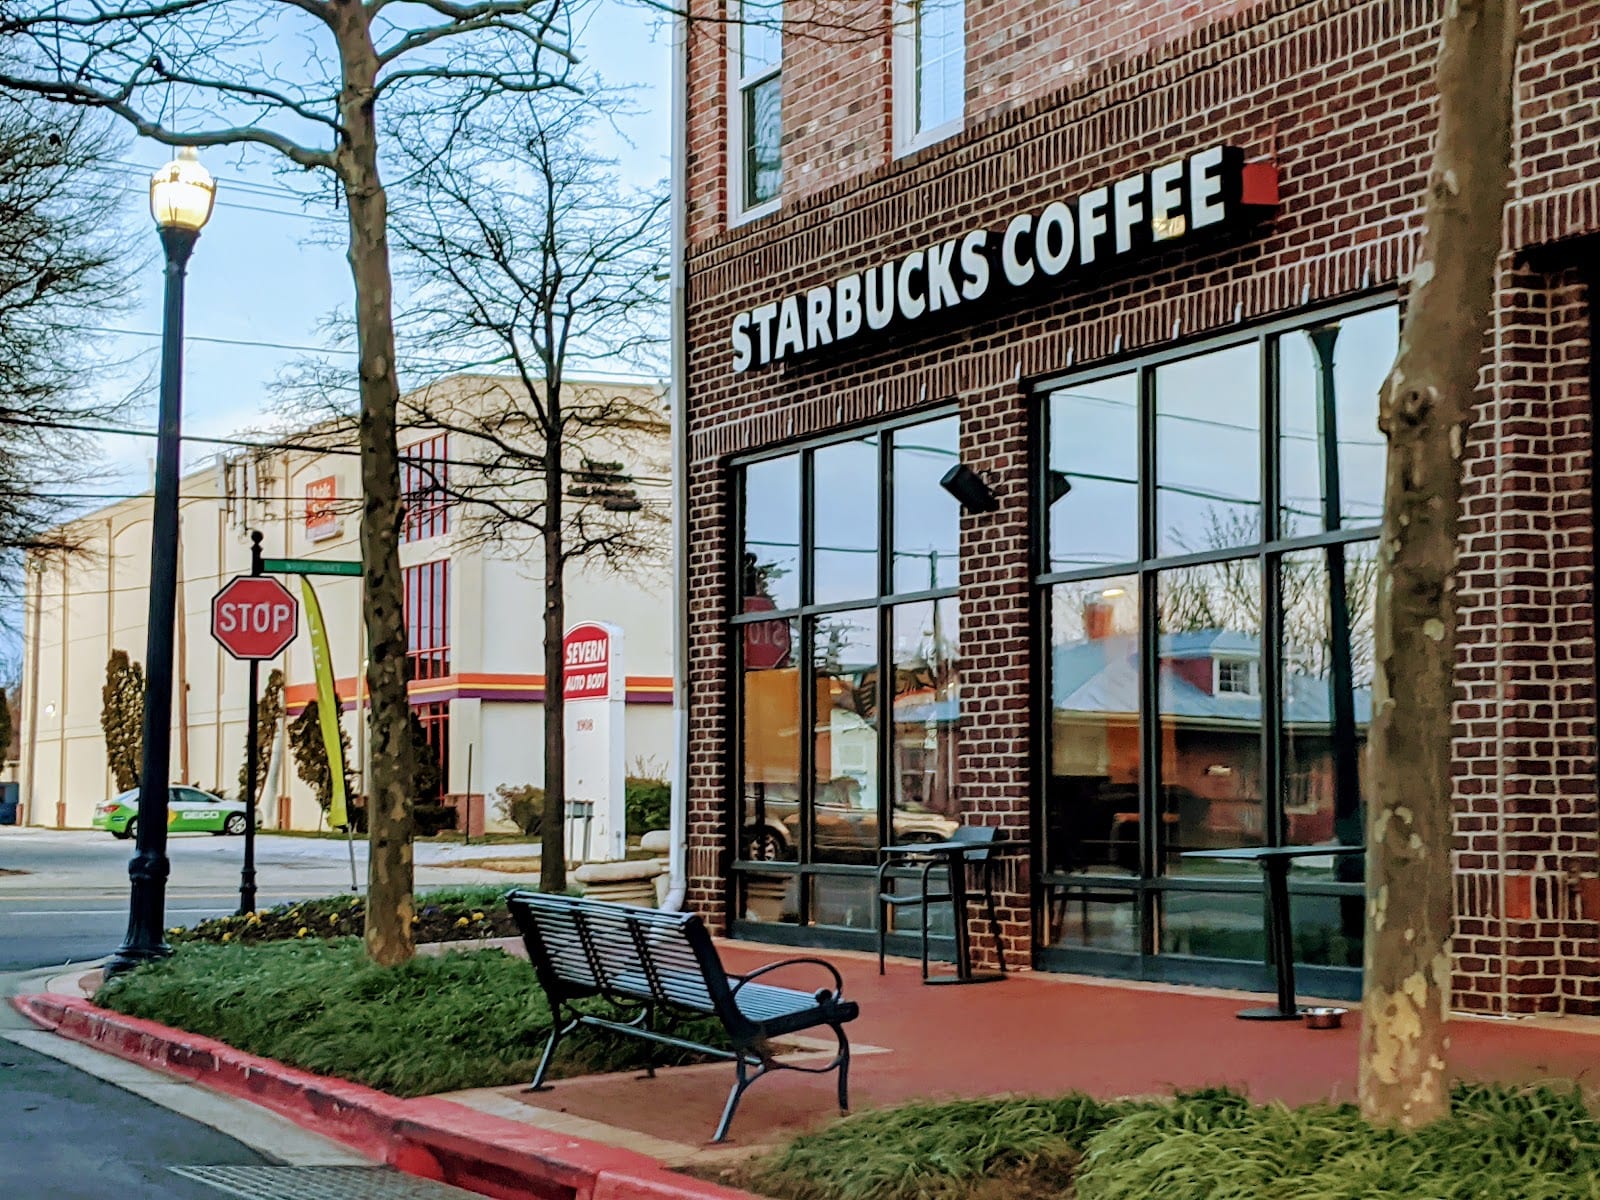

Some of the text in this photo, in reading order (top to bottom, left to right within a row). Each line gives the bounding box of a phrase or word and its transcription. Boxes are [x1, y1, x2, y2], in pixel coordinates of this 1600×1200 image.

[731, 144, 1226, 374] STARBUCKS COFFEE
[219, 602, 290, 633] STOP
[565, 638, 607, 665] SEVERN
[565, 672, 607, 692] AUTO BODY
